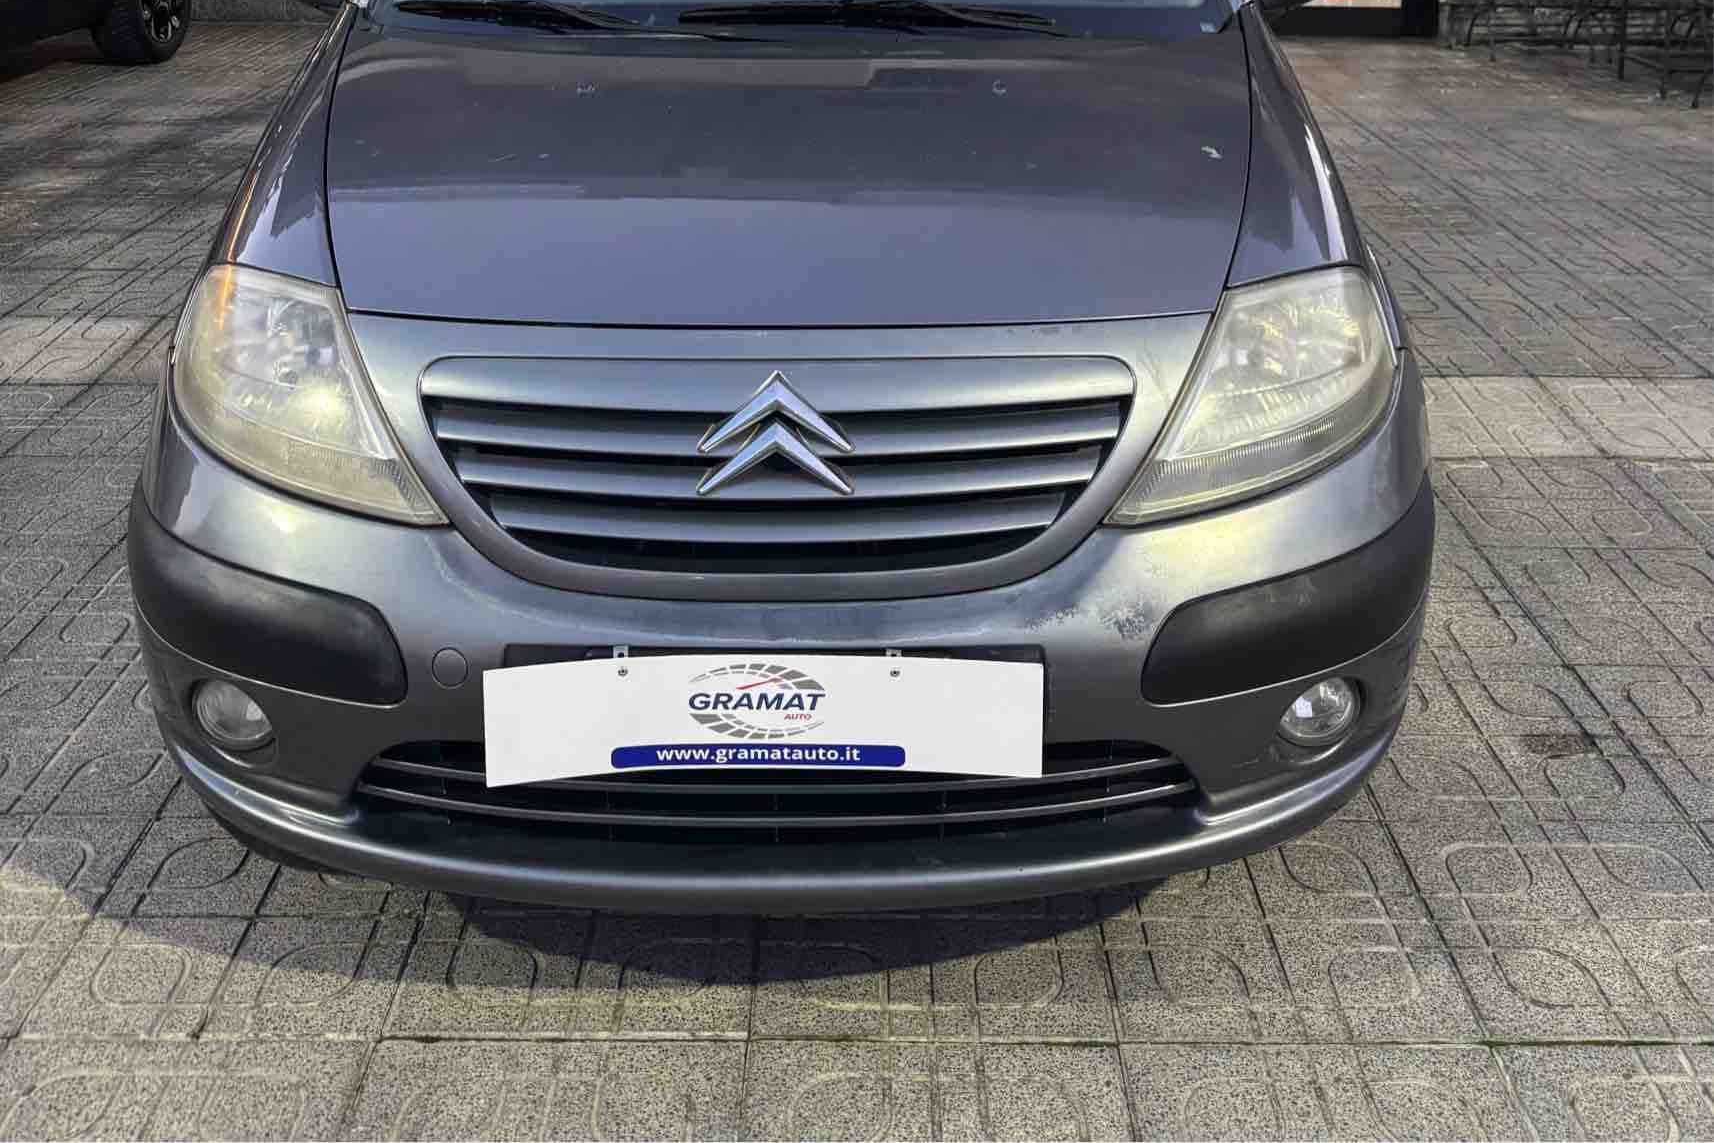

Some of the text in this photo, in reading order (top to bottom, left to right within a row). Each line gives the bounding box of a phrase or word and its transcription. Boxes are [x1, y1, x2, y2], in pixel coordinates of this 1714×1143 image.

[688, 692, 826, 711] GRAMAT
[783, 713, 812, 721] AUTO
[655, 745, 861, 765] www.gramatauto.it
